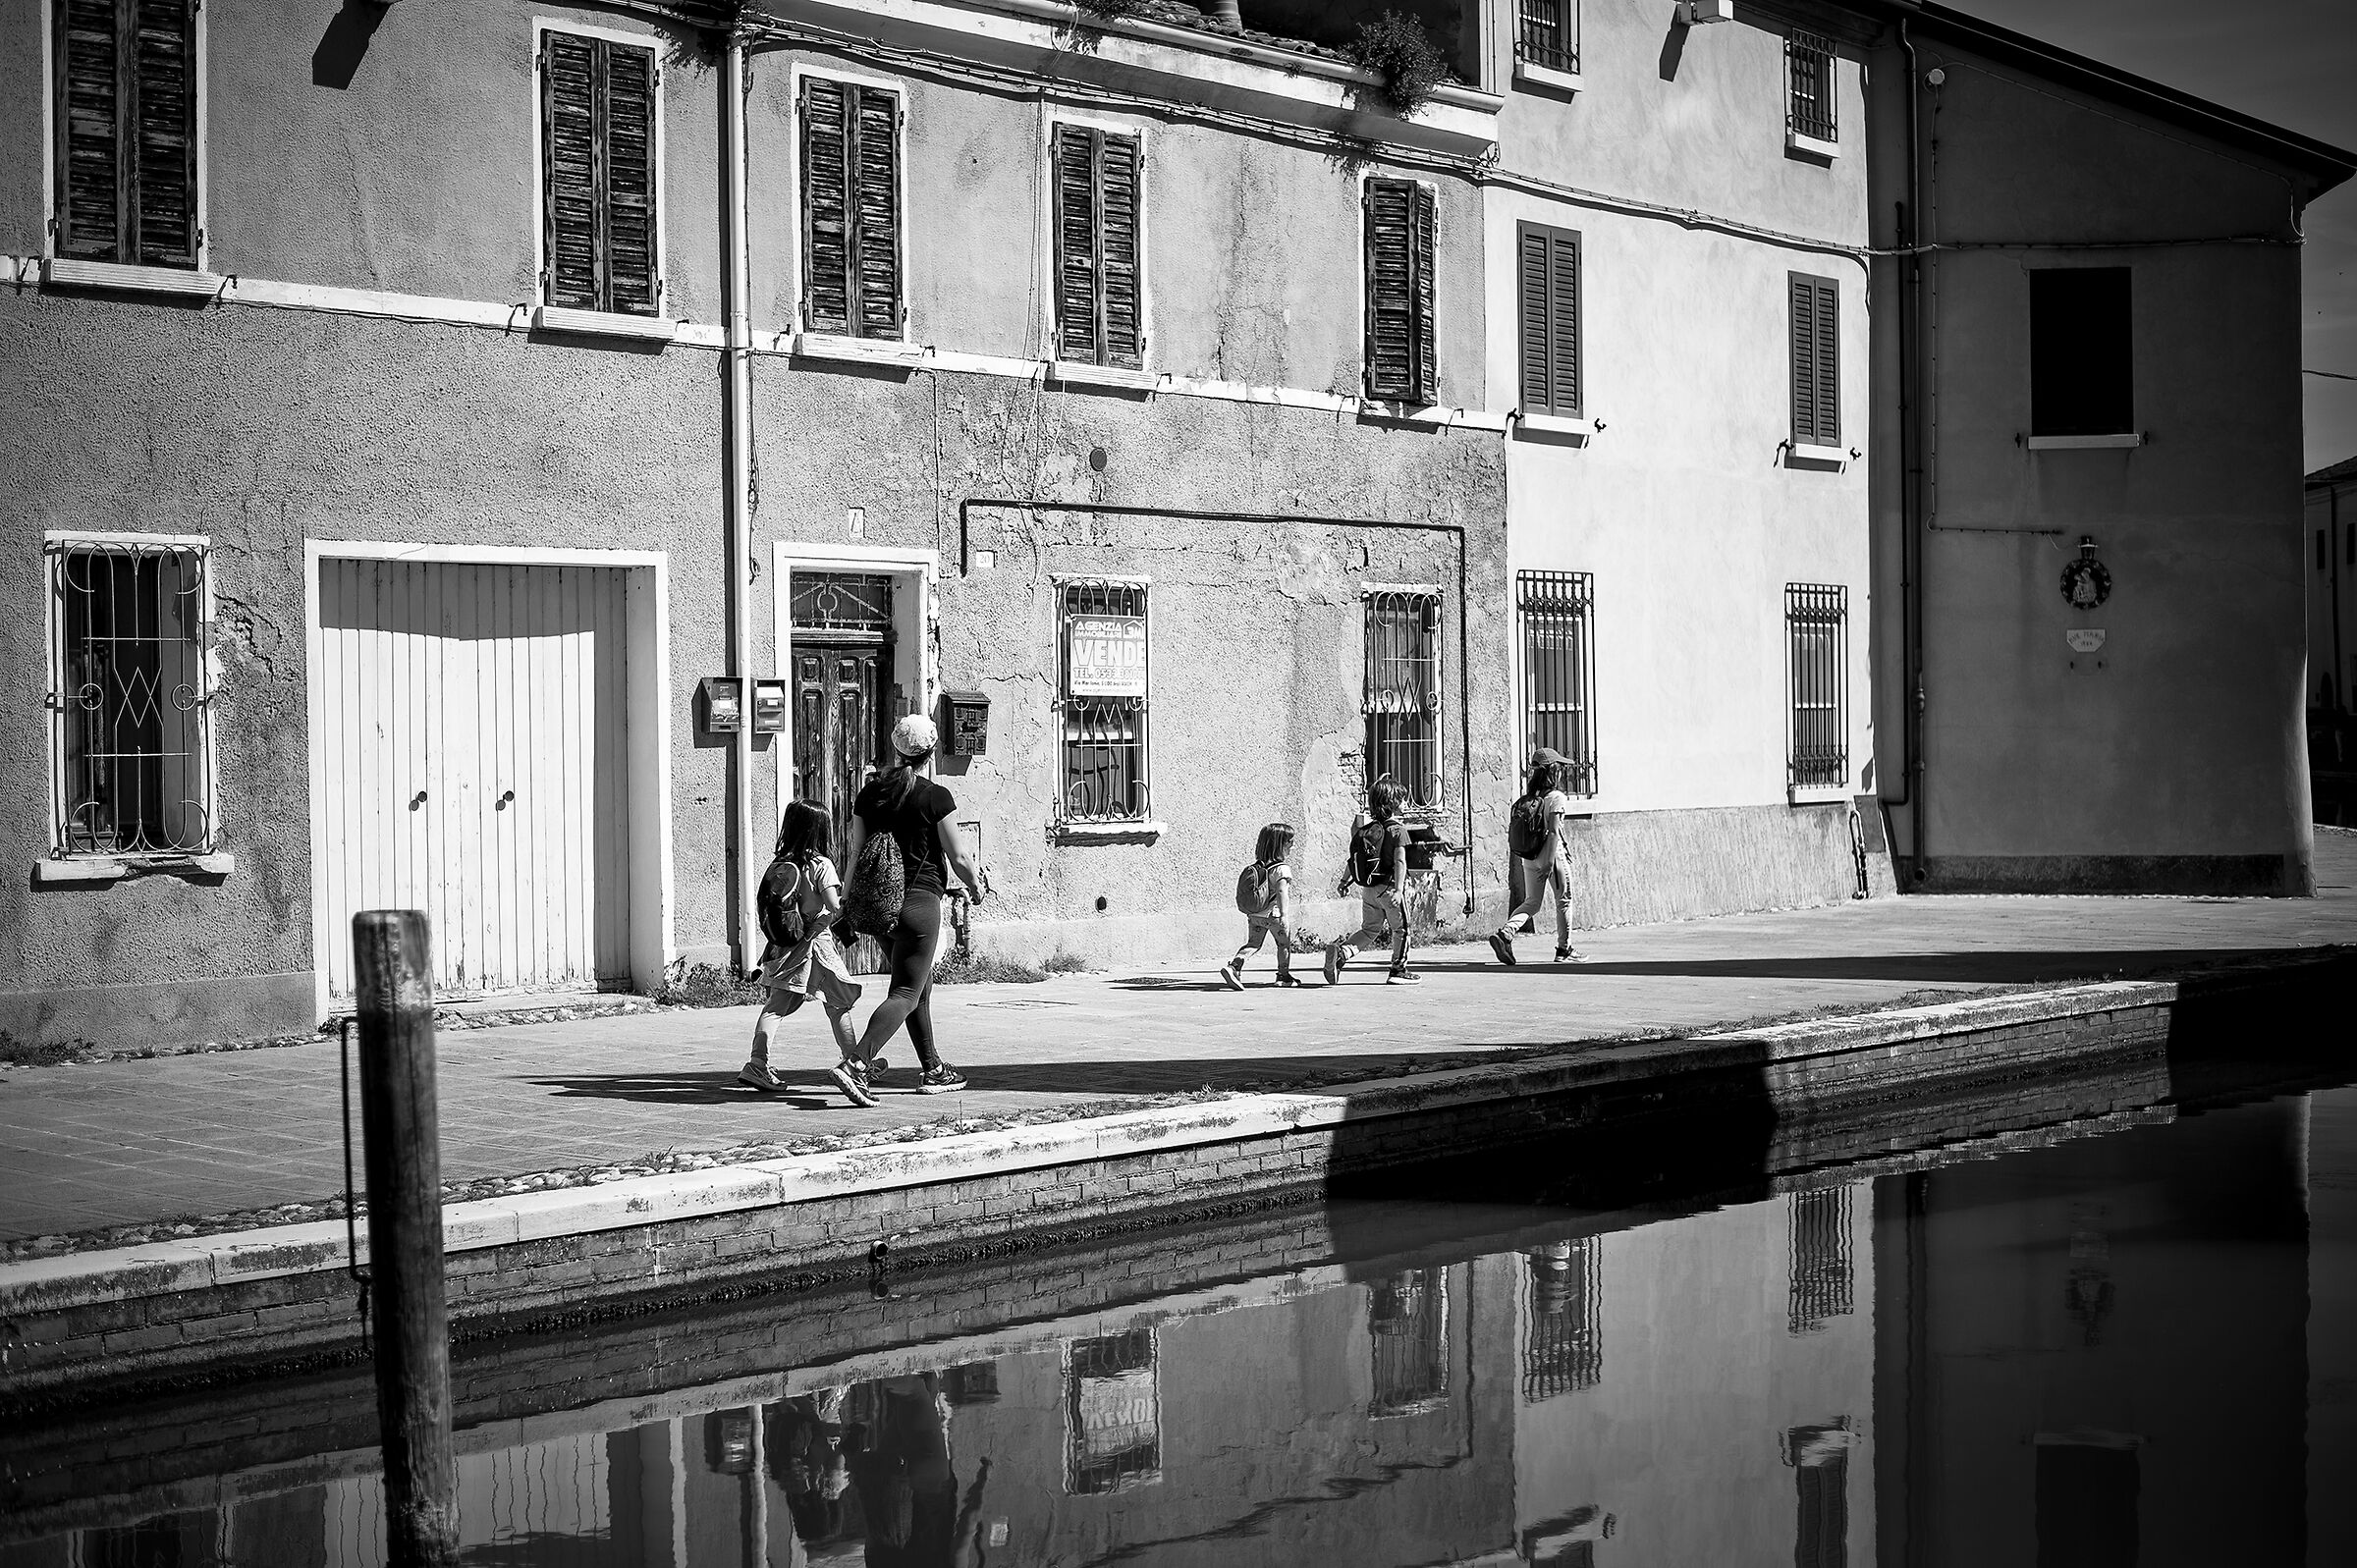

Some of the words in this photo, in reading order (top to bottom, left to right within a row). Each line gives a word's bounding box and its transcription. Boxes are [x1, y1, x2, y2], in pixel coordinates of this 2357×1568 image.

[1074, 621, 1123, 632] AGENZIA
[1073, 639, 1145, 669] VENDE
[1072, 667, 1094, 678] TEL.
